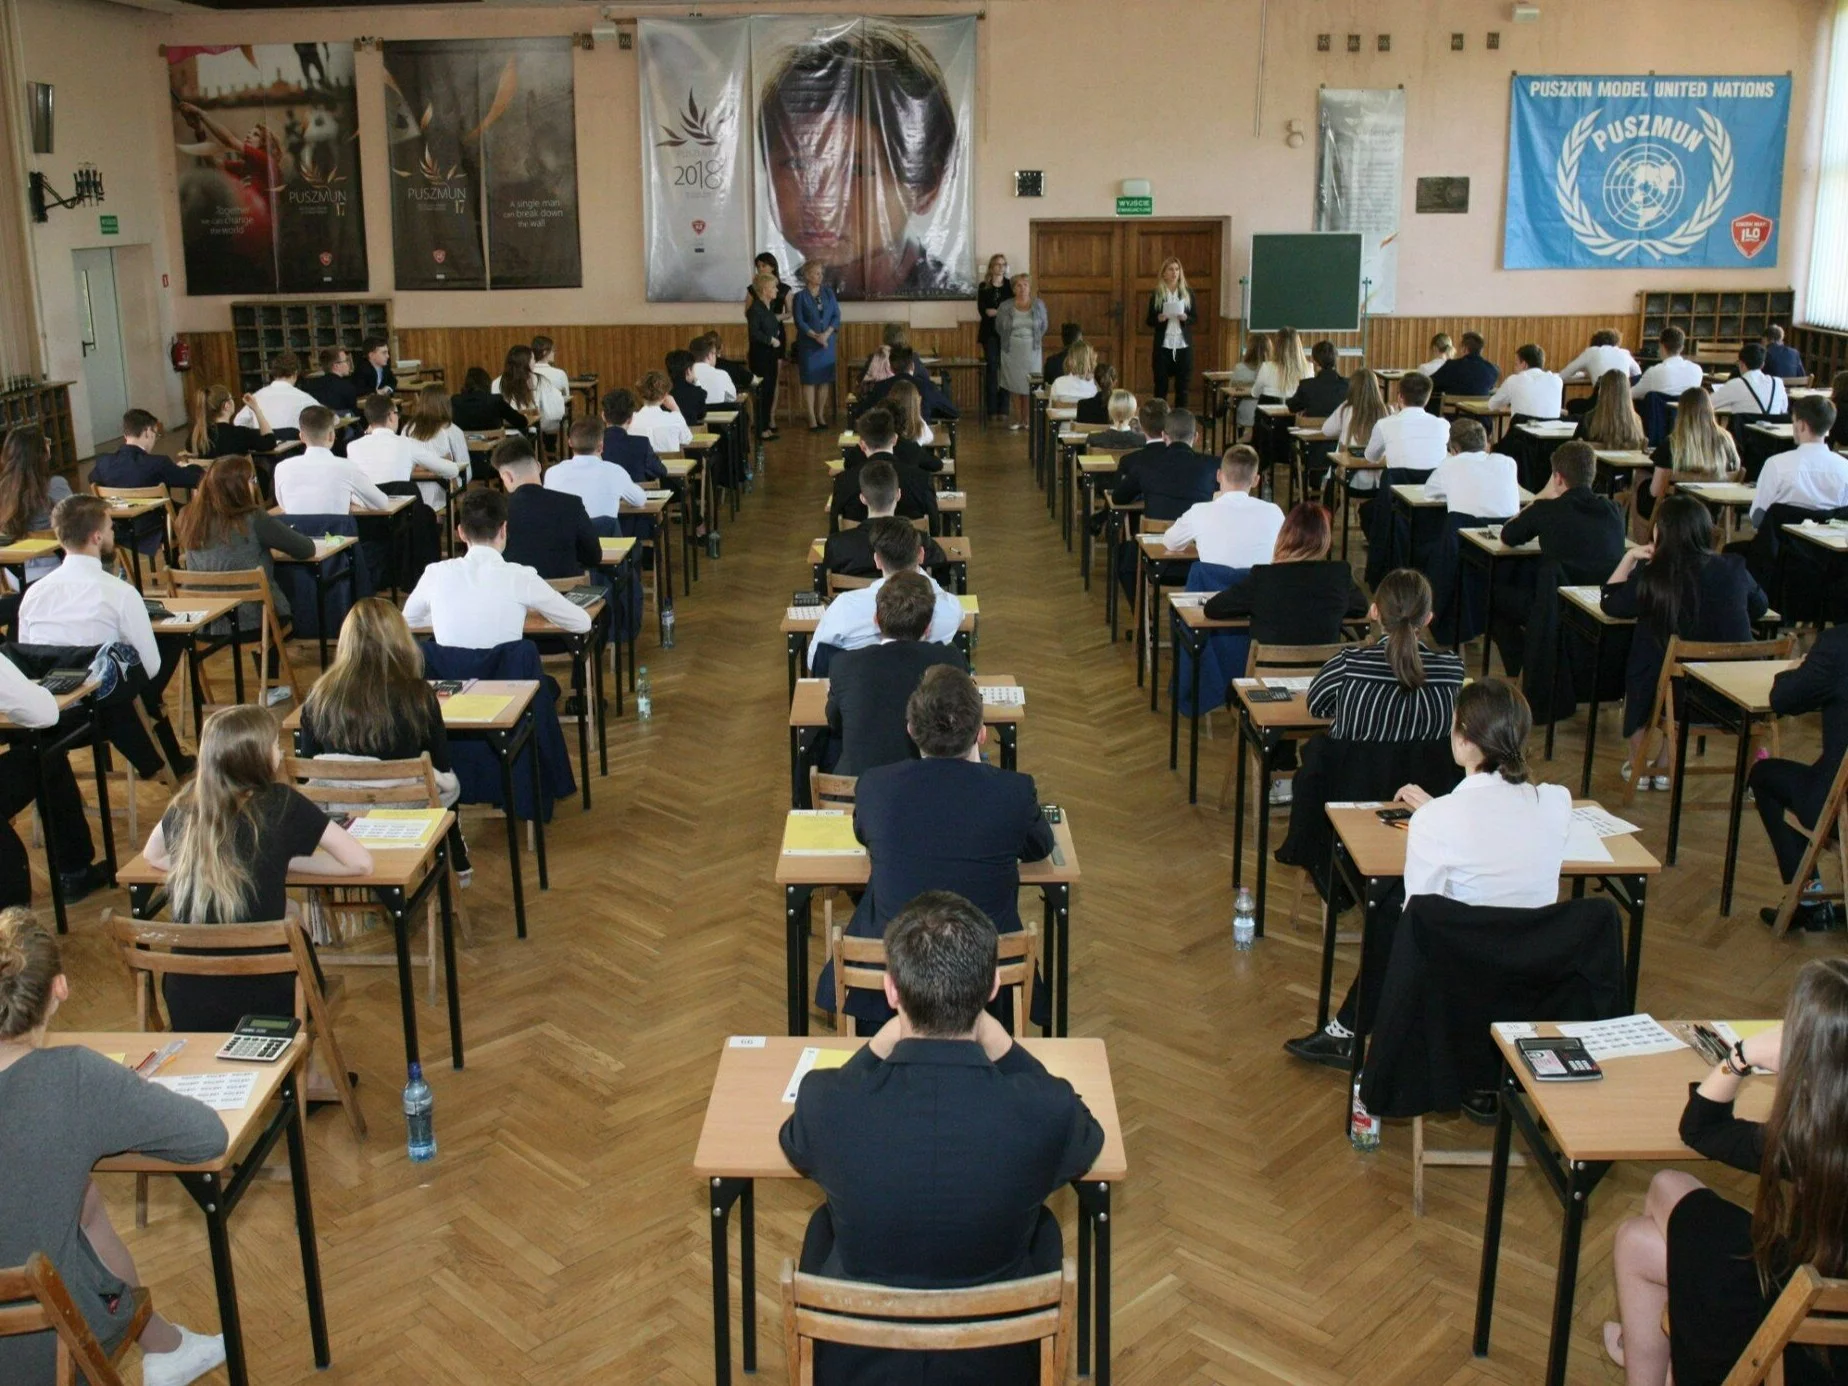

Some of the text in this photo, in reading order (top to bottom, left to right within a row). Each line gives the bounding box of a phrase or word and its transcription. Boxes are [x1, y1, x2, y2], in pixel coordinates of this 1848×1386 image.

[1529, 81, 1775, 98] PUSZKIN MODEL UNITED NATIONS
[1591, 115, 1706, 153] PUSZMUN
[673, 159, 725, 190] 2018
[289, 190, 347, 203] PUSZMUN
[408, 187, 466, 200] PUSZMUN
[336, 202, 345, 217] 17
[455, 199, 465, 214] 17
[516, 199, 540, 210] single
[516, 209, 538, 217] break
[540, 209, 564, 217] down
[530, 219, 546, 228] wall
